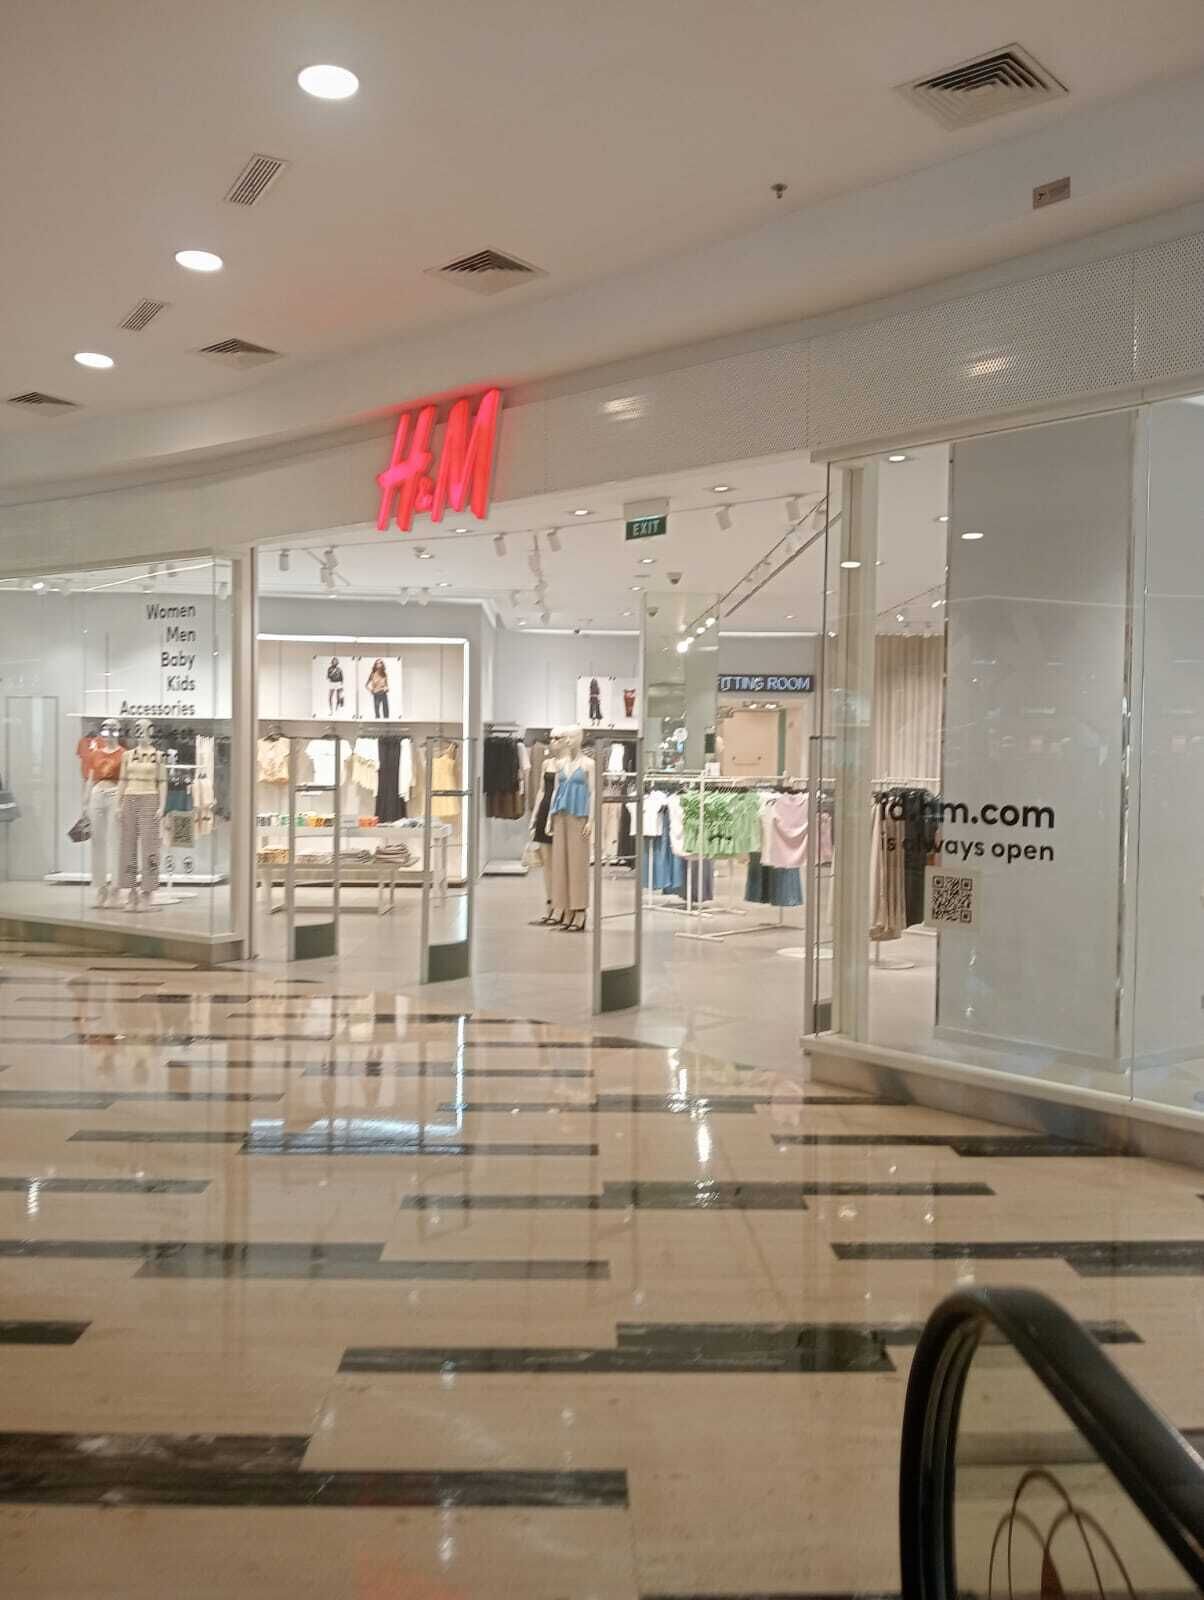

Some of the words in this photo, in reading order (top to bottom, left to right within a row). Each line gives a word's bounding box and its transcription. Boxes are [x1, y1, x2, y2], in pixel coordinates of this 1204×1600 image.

[376, 388, 500, 531] H&M
[632, 519, 660, 537] EXIT
[146, 604, 196, 619] Women
[166, 626, 196, 642] Men
[161, 651, 196, 670] Baby
[167, 675, 195, 691] Kids
[720, 676, 764, 691] ITTING
[767, 677, 810, 690] ROOM
[120, 700, 195, 715] Accessories
[881, 832, 896, 851] is
[991, 842, 1054, 864] open
